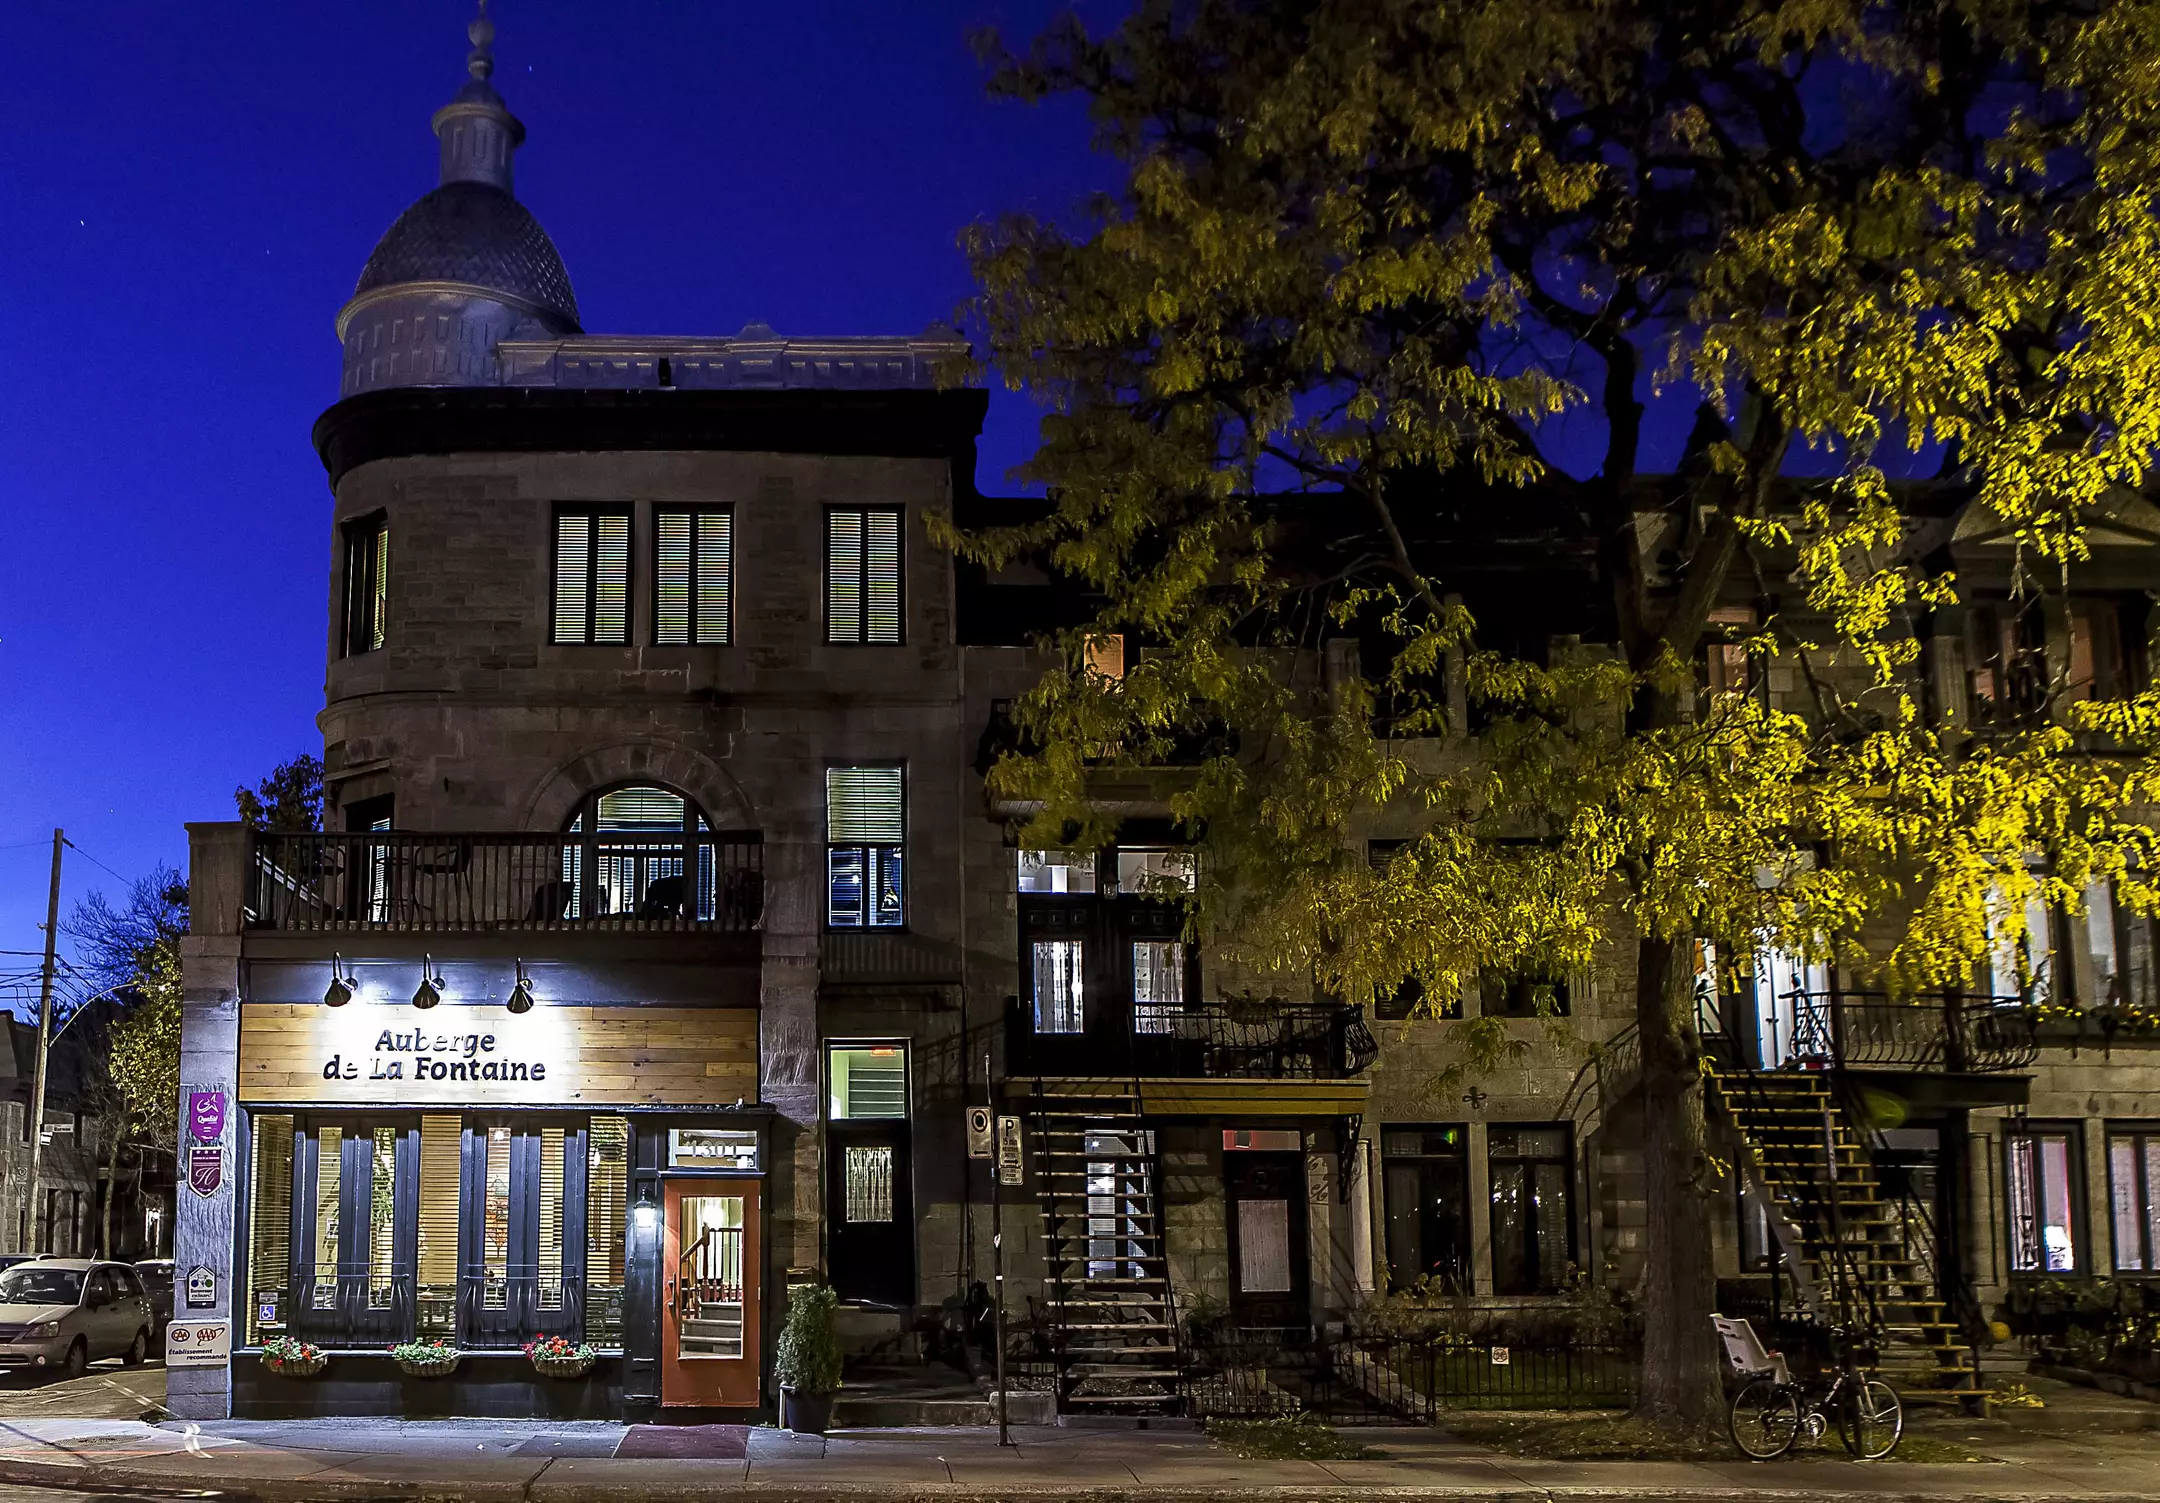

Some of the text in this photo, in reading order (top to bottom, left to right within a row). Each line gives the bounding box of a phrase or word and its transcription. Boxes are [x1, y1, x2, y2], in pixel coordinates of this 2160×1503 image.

[374, 1028, 496, 1058] Auberge
[322, 1055, 546, 1081] de La Fontaine
[689, 1140, 738, 1158] 1301
